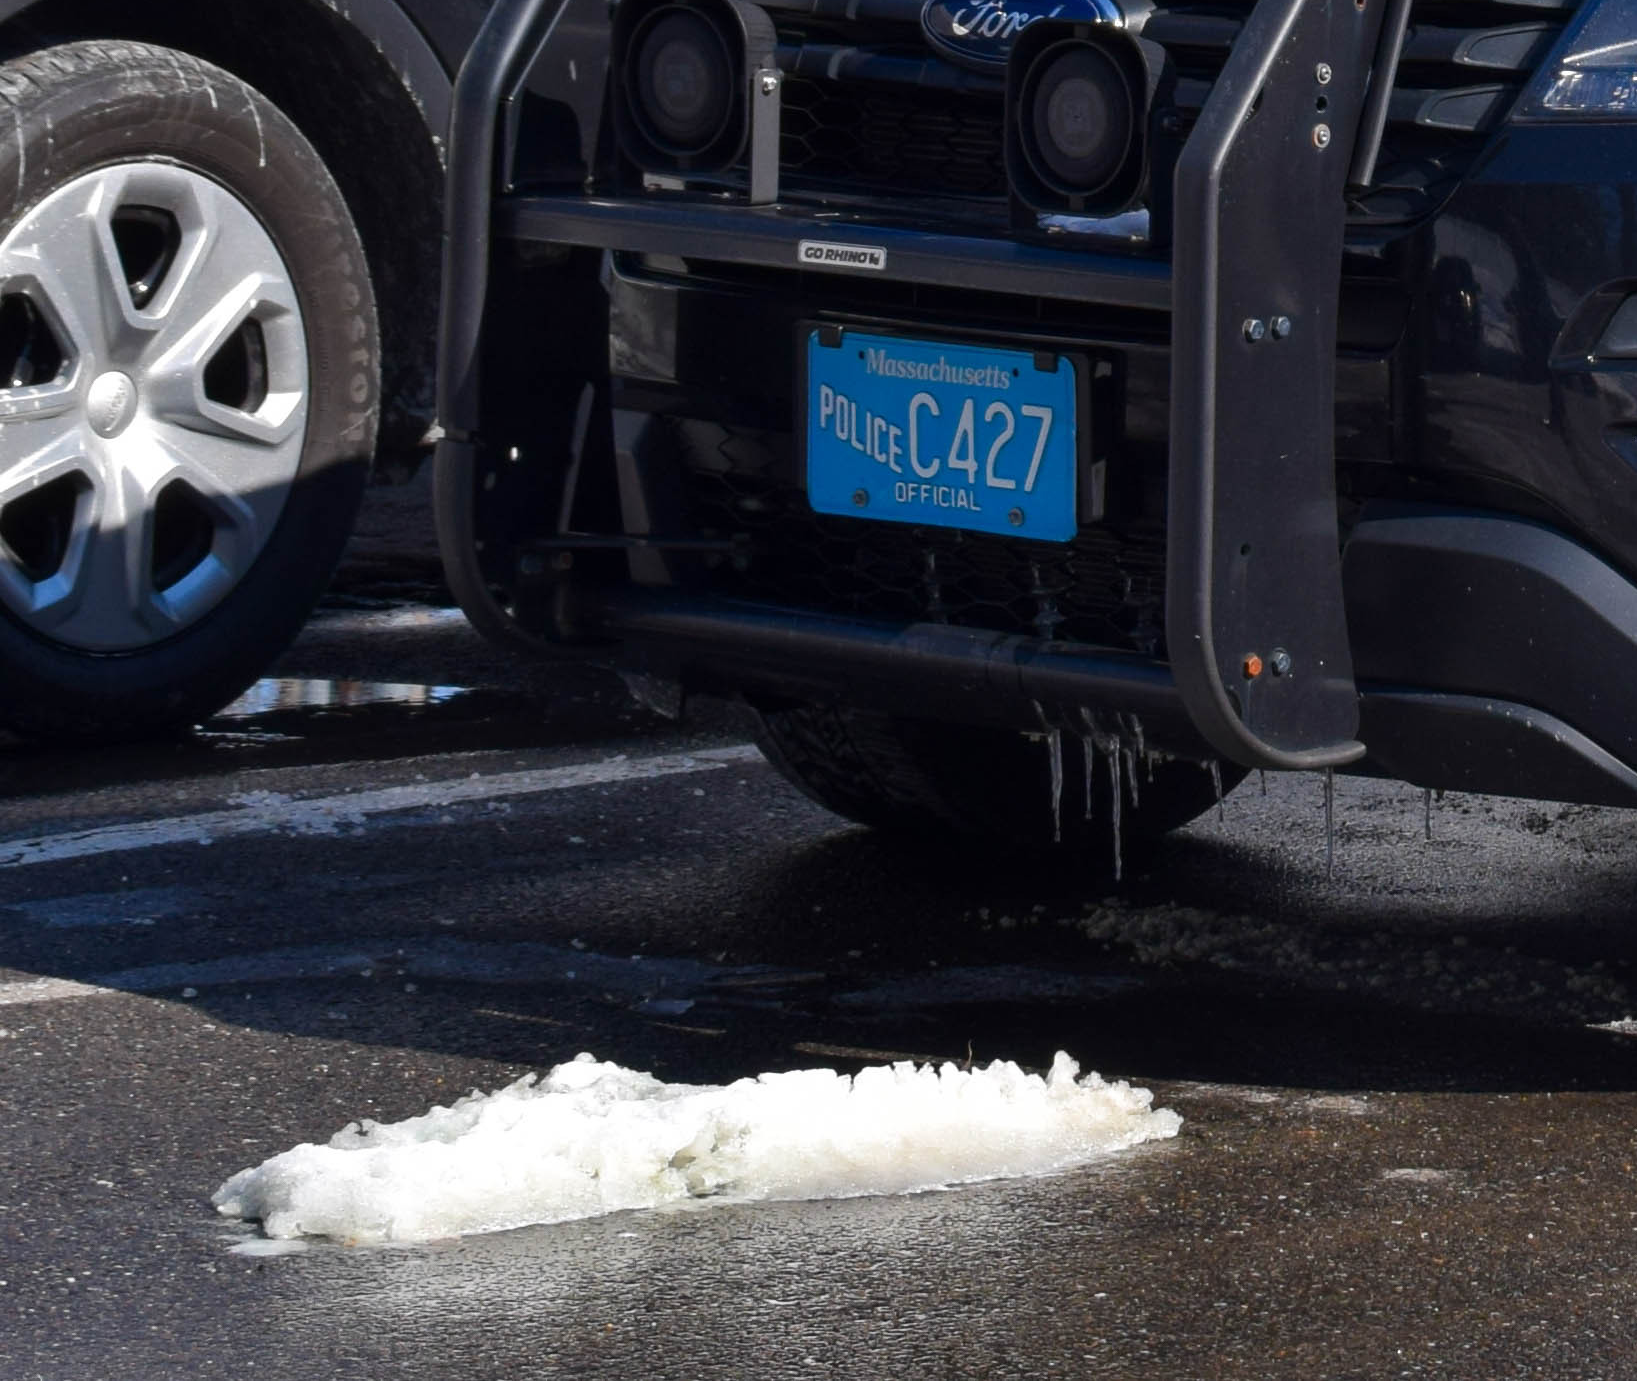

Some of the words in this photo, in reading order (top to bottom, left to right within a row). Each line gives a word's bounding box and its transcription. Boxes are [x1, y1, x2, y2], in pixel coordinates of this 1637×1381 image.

[804, 246, 824, 261] GO
[825, 248, 868, 265] RHINO
[865, 347, 1011, 390] Massachusetts
[819, 383, 904, 475] POLICE
[908, 391, 1054, 493] C427
[895, 481, 982, 512] OFFICIAL
